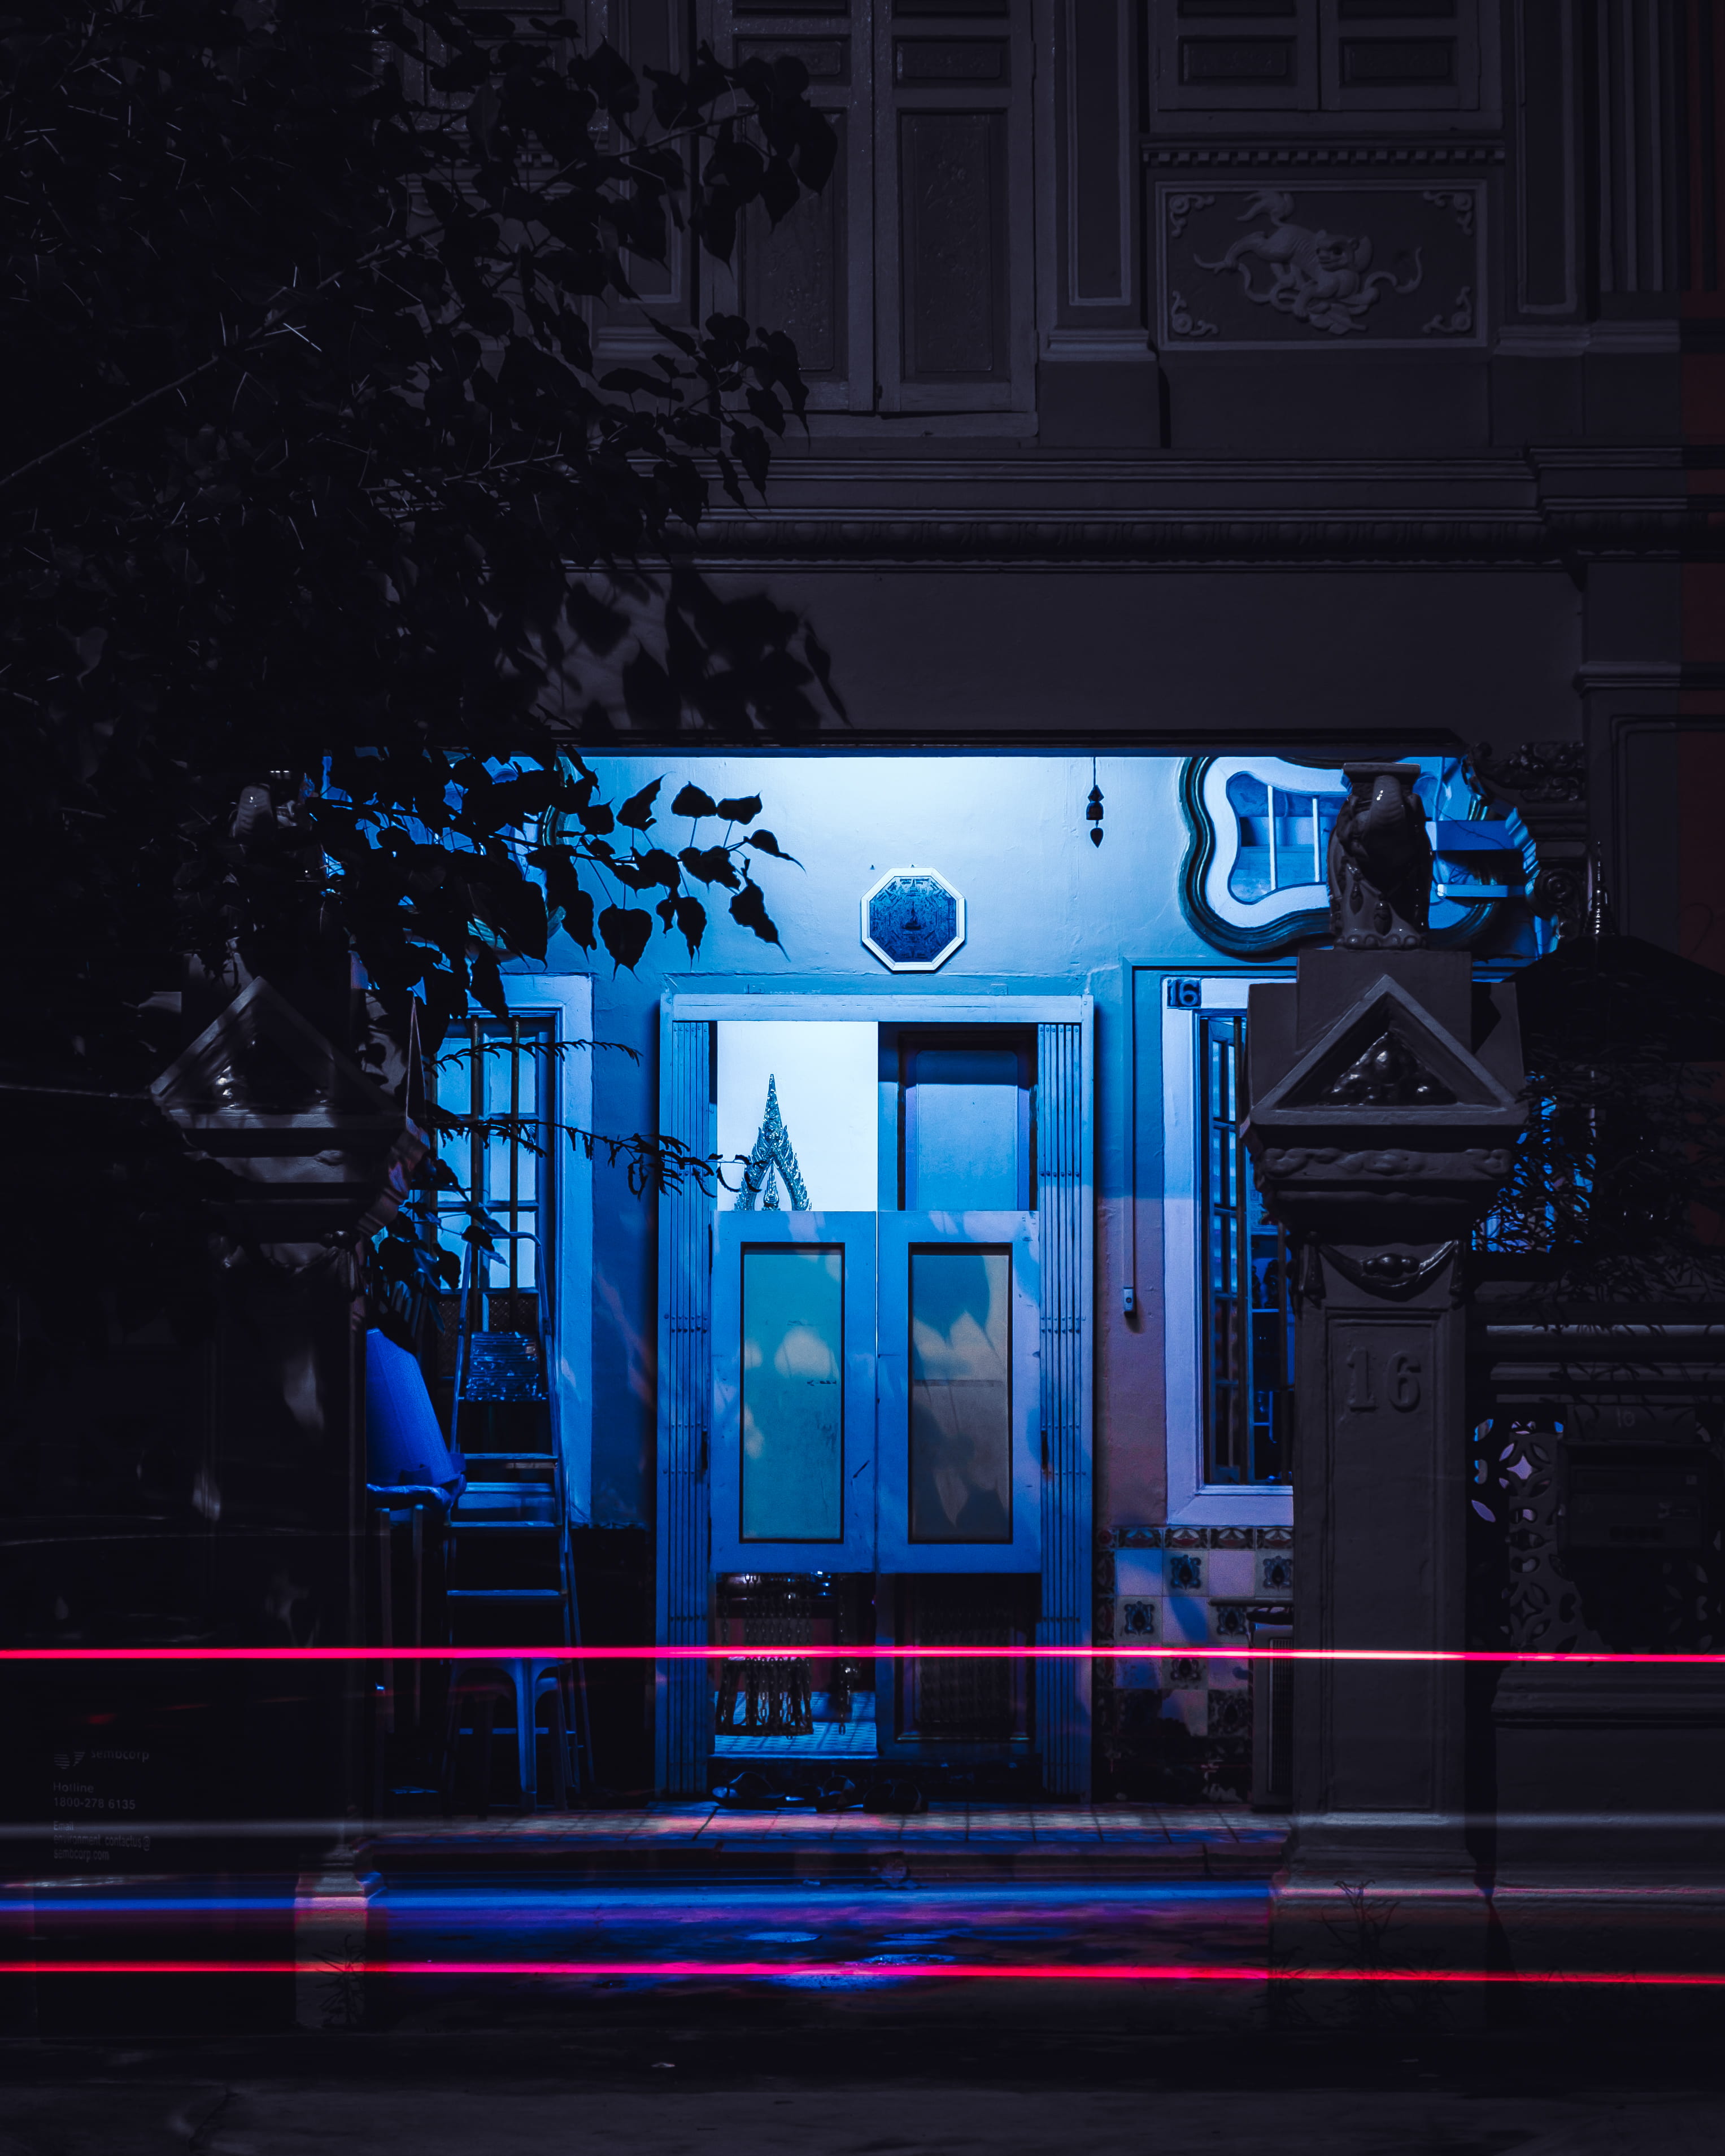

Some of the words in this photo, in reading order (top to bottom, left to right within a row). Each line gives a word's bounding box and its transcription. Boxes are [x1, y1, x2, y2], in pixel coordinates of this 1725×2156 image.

[1168, 979, 1199, 1006] 16
[1346, 1346, 1421, 1413] 16
[53, 1781, 94, 1793] Hotline
[54, 1797, 104, 1808] 1800-278
[108, 1799, 136, 1810] 6135
